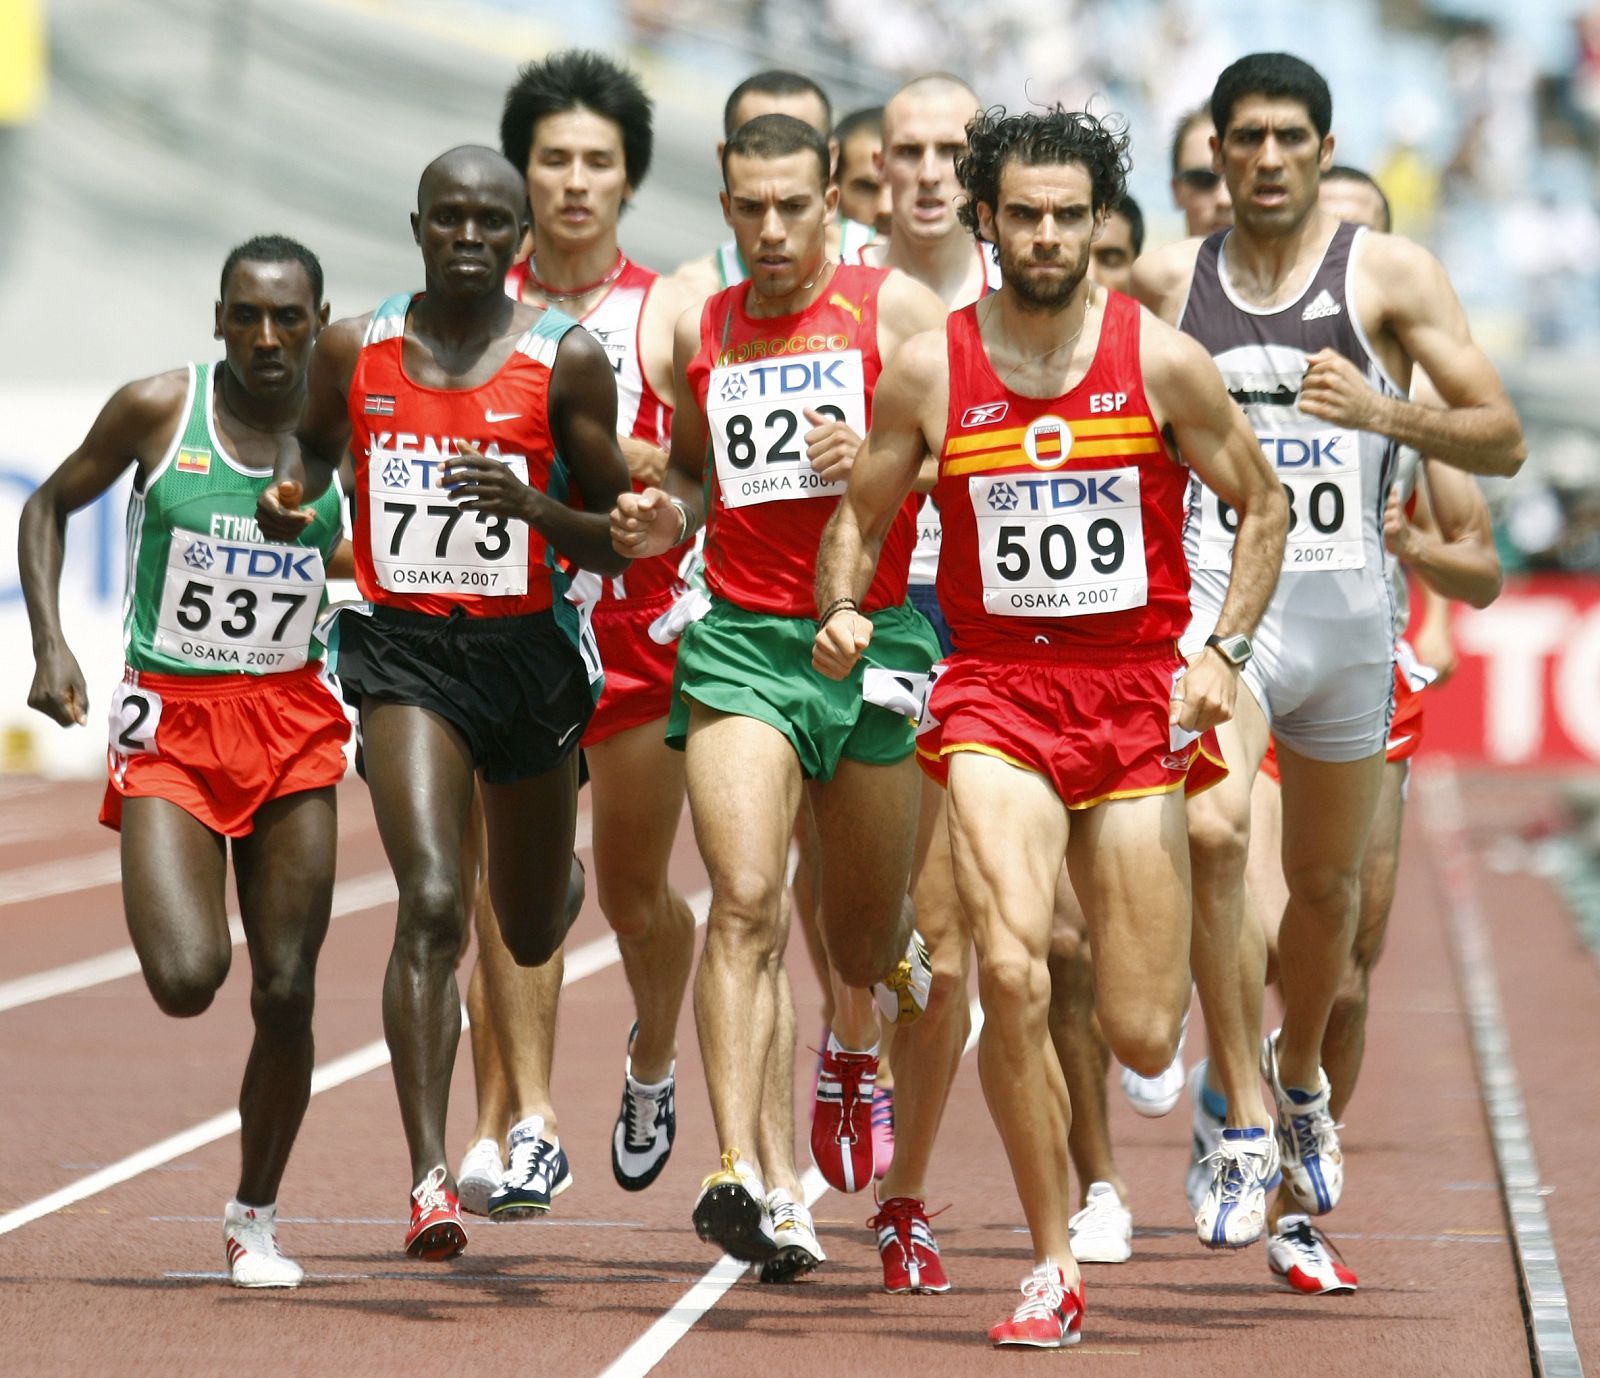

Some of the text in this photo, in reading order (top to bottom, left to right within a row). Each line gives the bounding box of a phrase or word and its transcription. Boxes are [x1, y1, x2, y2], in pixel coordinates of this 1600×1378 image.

[715, 335, 848, 368] MOROCCO
[749, 360, 847, 397] TDK
[1090, 392, 1127, 414] ESP
[742, 476, 792, 496] OSAKA
[1016, 476, 1126, 511] TDK
[209, 513, 287, 546] ETHIO
[383, 502, 511, 562] 773
[216, 545, 318, 583] TDK
[996, 518, 1125, 582] 509
[1294, 548, 1335, 563] 2007
[393, 570, 499, 587] OSAKA 2007
[176, 580, 308, 642] 537
[1010, 587, 1119, 609] OSAKA 2007
[181, 641, 285, 666] OSAKA 2007
[118, 694, 151, 750] 2
